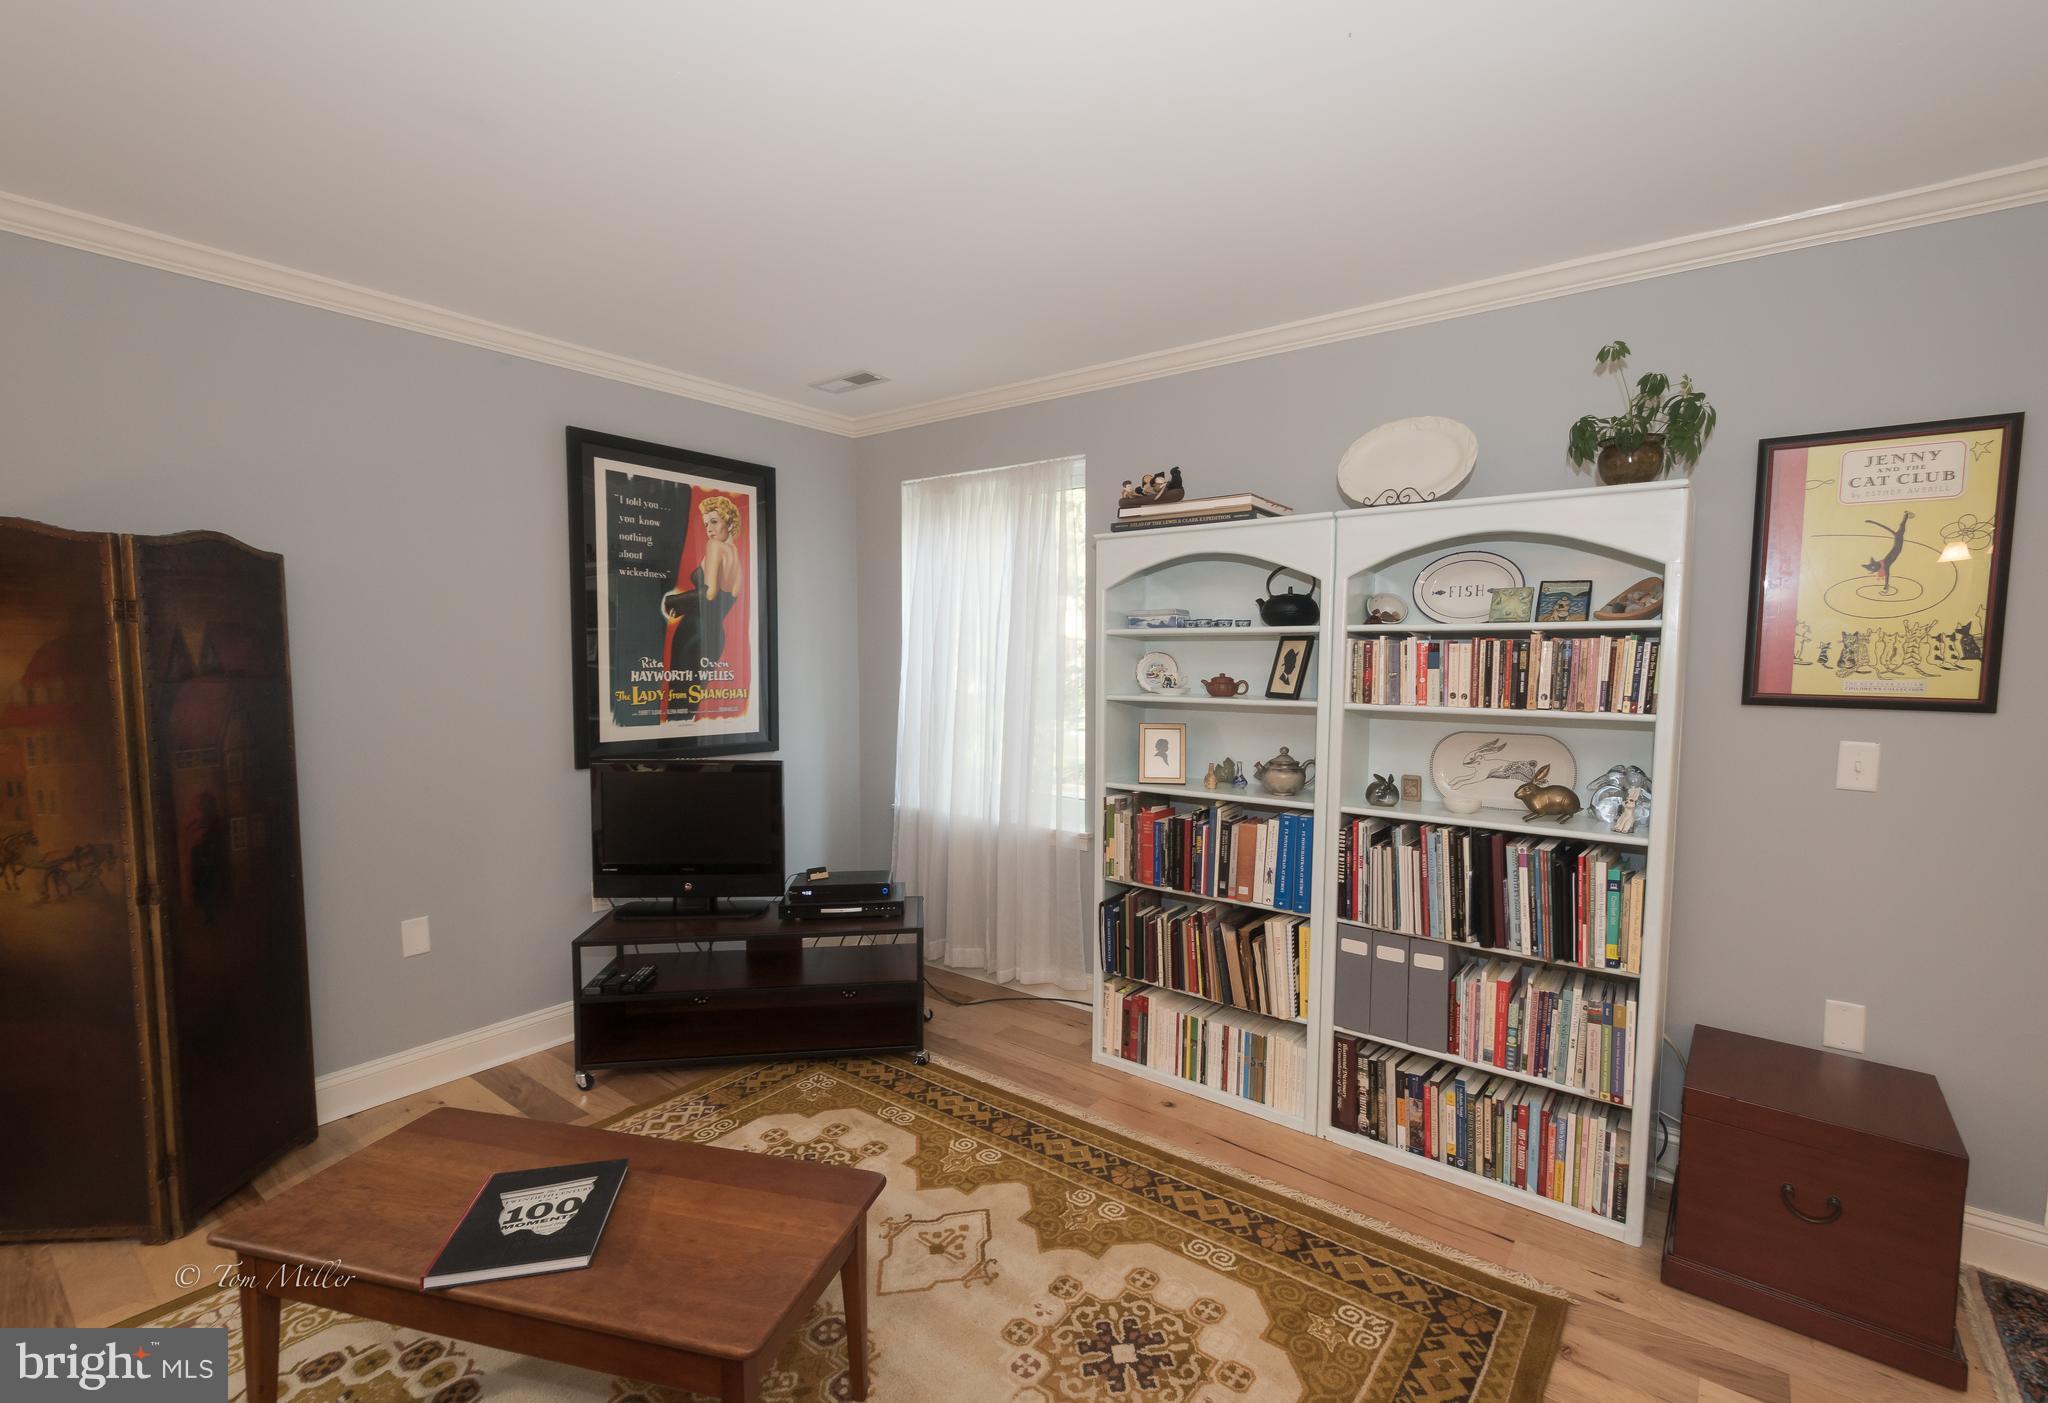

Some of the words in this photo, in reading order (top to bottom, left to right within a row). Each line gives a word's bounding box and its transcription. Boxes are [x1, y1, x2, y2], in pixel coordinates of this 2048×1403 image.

[1864, 449, 1942, 468] JENNY
[1848, 475, 1891, 488] CAT
[1896, 470, 1956, 485] CLUB
[625, 497, 641, 506] told
[618, 515, 635, 524] you
[638, 515, 660, 527] know
[618, 533, 653, 546] nothing
[618, 549, 643, 560] about
[1448, 584, 1485, 598] FISH
[639, 656, 664, 669] Rita
[631, 670, 693, 682] HAYWORTH
[699, 670, 735, 681] WELLES
[615, 690, 631, 702] The
[631, 686, 666, 706] LADY
[668, 689, 688, 702] from
[688, 684, 748, 704] SHANGHAI
[503, 1197, 583, 1225] 100
[501, 1214, 576, 1230] MOMENTS
